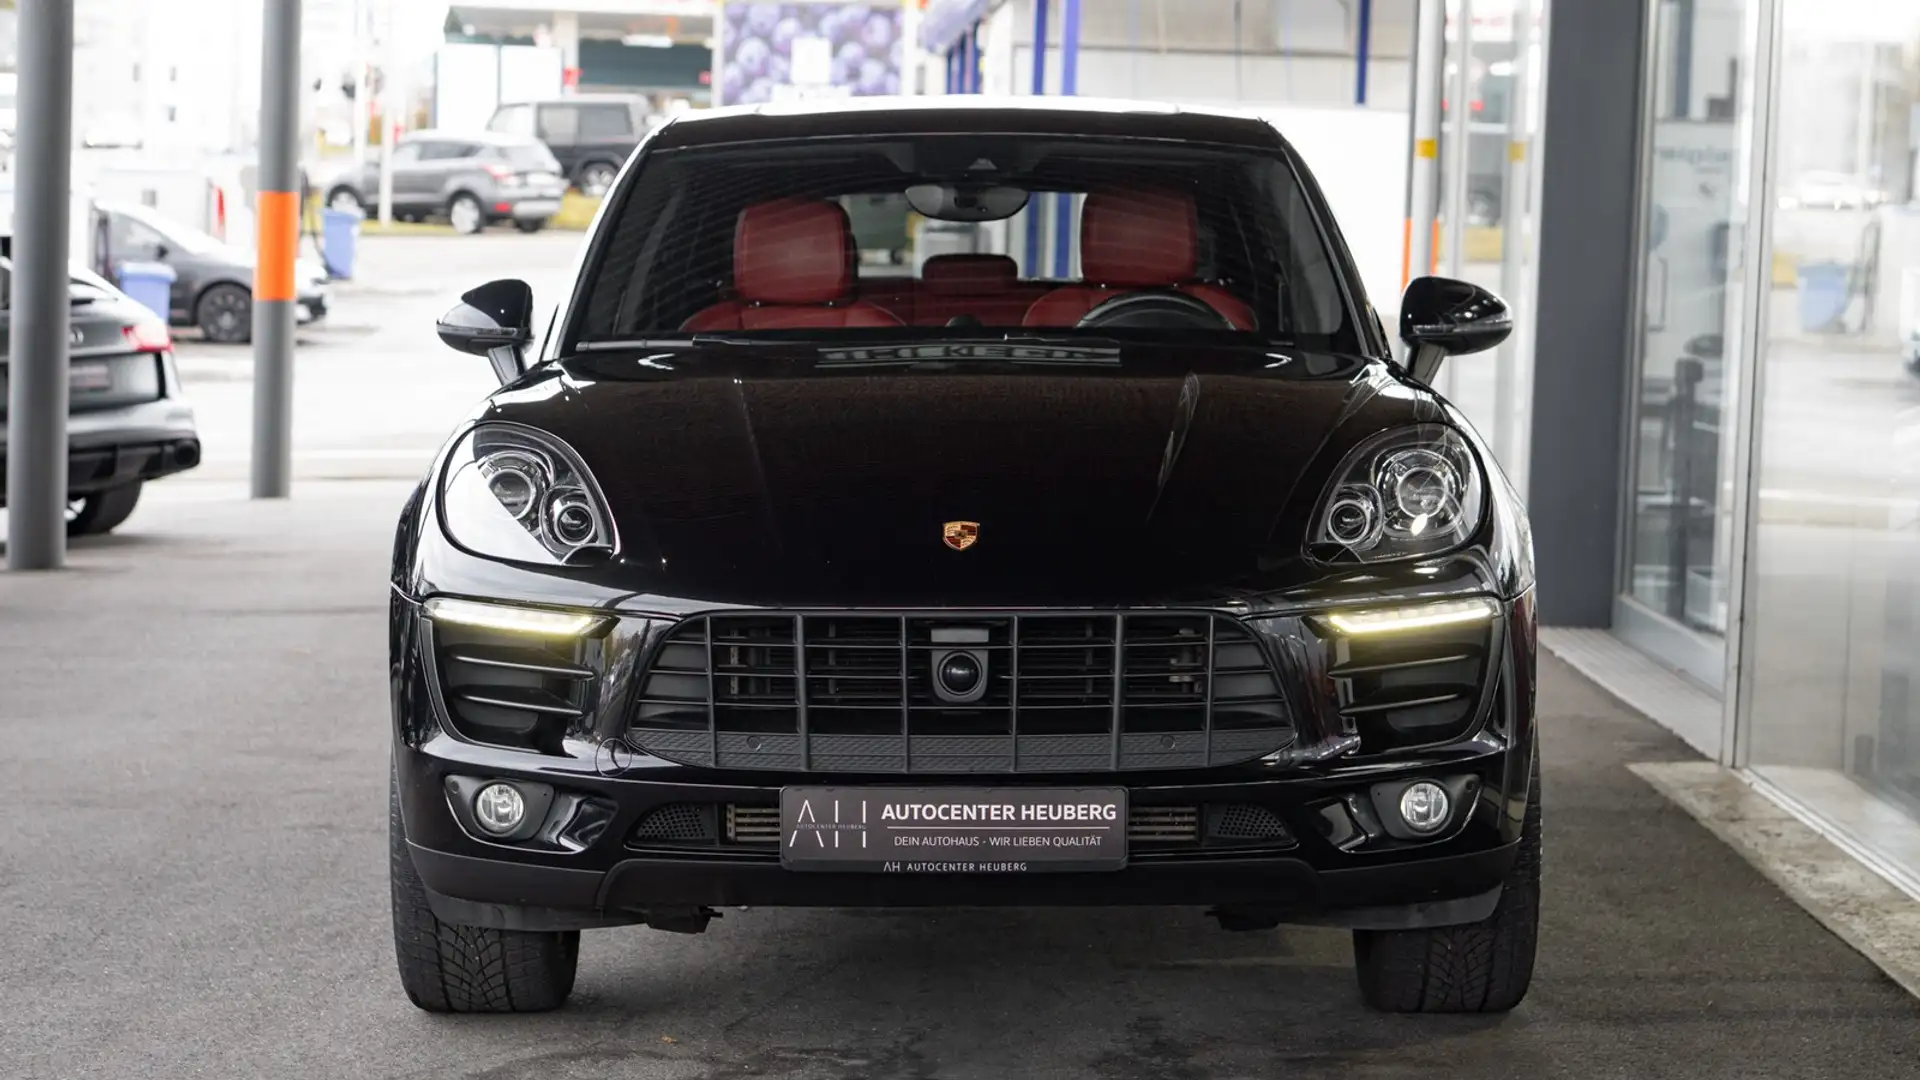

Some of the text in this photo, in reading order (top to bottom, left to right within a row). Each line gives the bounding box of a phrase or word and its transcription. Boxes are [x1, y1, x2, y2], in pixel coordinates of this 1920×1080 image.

[880, 803, 1117, 821] AUTOCENTER HEUBERG
[894, 836, 920, 846] DEIN
[921, 836, 980, 846] AUTOHAUS
[988, 836, 1011, 846] WIR
[1013, 836, 1050, 846] LIEBEN
[1053, 835, 1103, 848] QUALITÄT
[906, 862, 975, 872] AUTOCENTER
[979, 862, 1027, 872] HEUBERG
